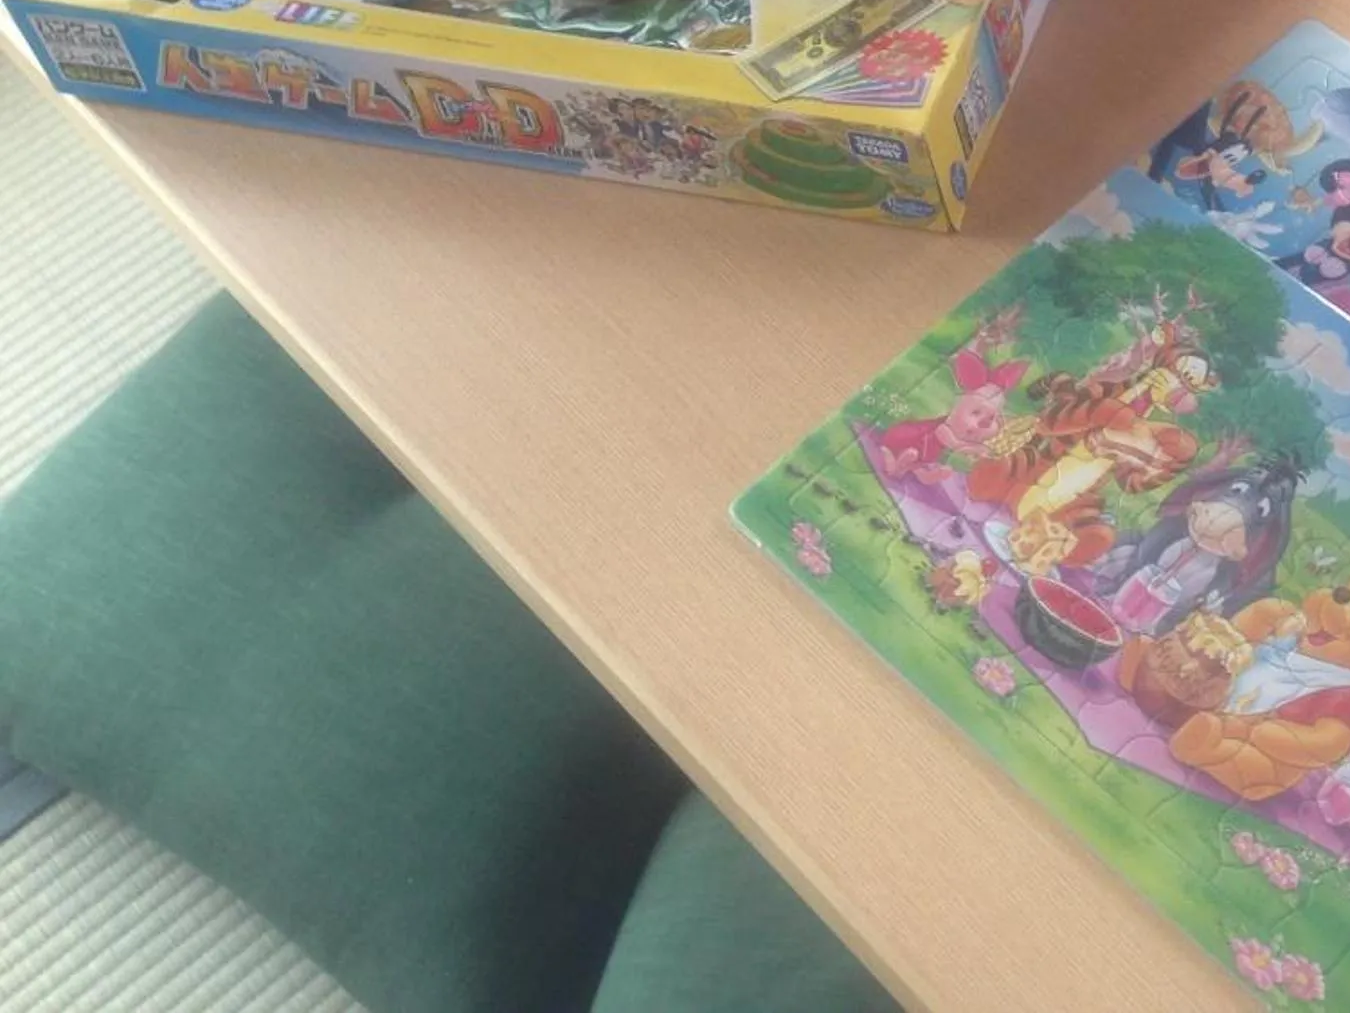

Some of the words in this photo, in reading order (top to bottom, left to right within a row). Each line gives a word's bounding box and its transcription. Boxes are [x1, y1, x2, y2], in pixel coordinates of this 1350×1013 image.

[276, 0, 360, 26] LIFE
[157, 40, 413, 123] 人生ゲーム
